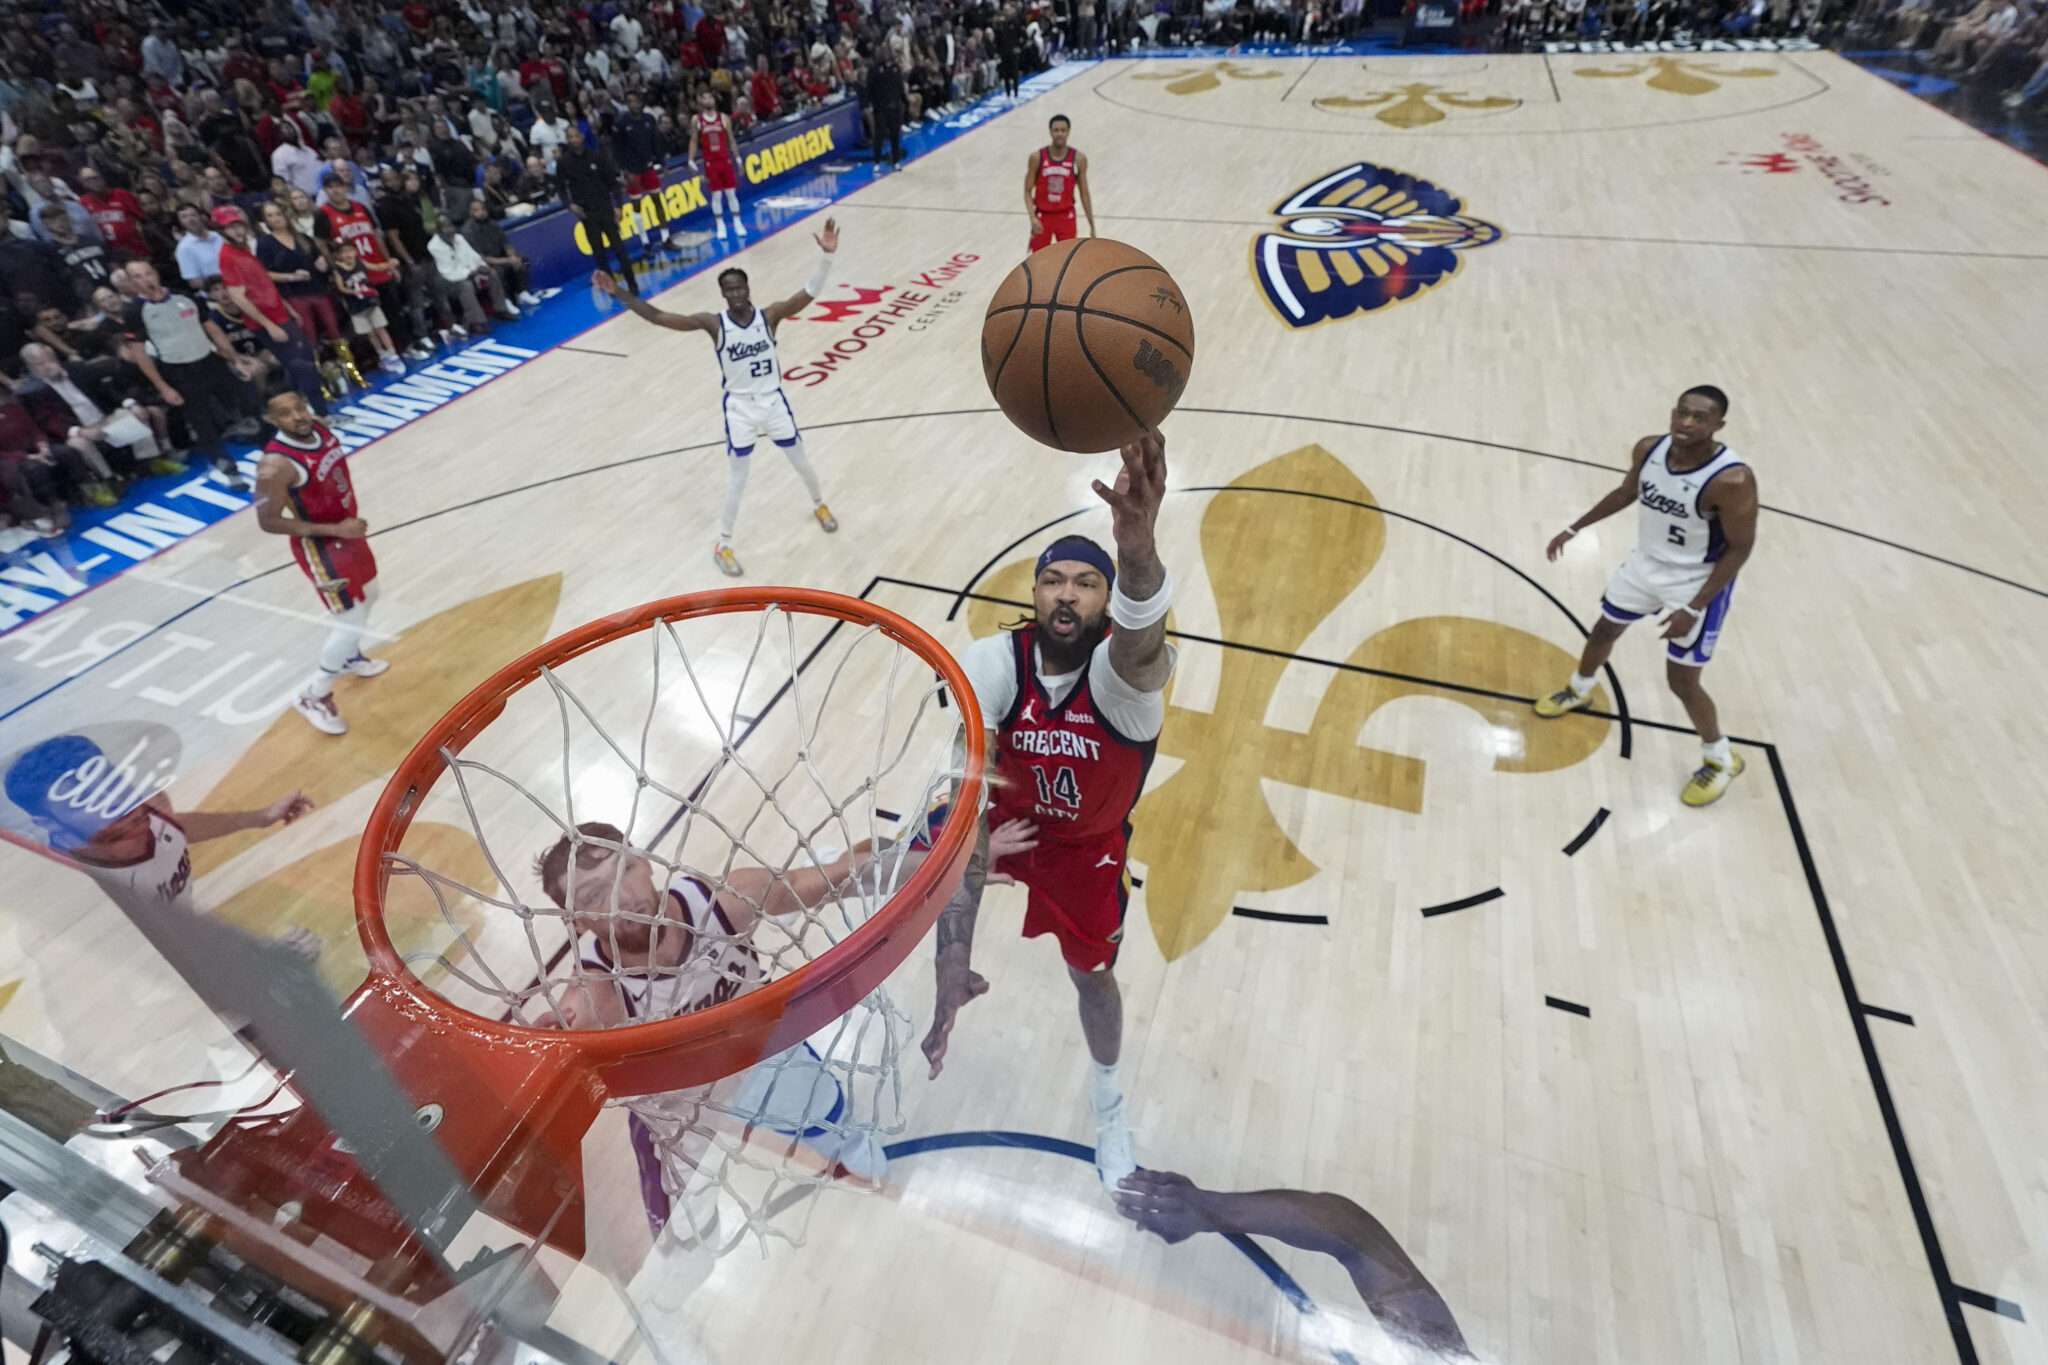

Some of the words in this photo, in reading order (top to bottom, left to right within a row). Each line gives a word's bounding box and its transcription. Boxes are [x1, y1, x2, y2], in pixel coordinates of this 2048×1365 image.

[908, 289, 967, 332] CENTER
[726, 338, 770, 362] Kings
[783, 289, 931, 387] SMOOTHIE
[750, 359, 773, 377] 23
[1640, 480, 1690, 519] Kings
[1667, 523, 1687, 546] 5
[1064, 709, 1095, 725] ibotta
[1030, 764, 1082, 809] 14
